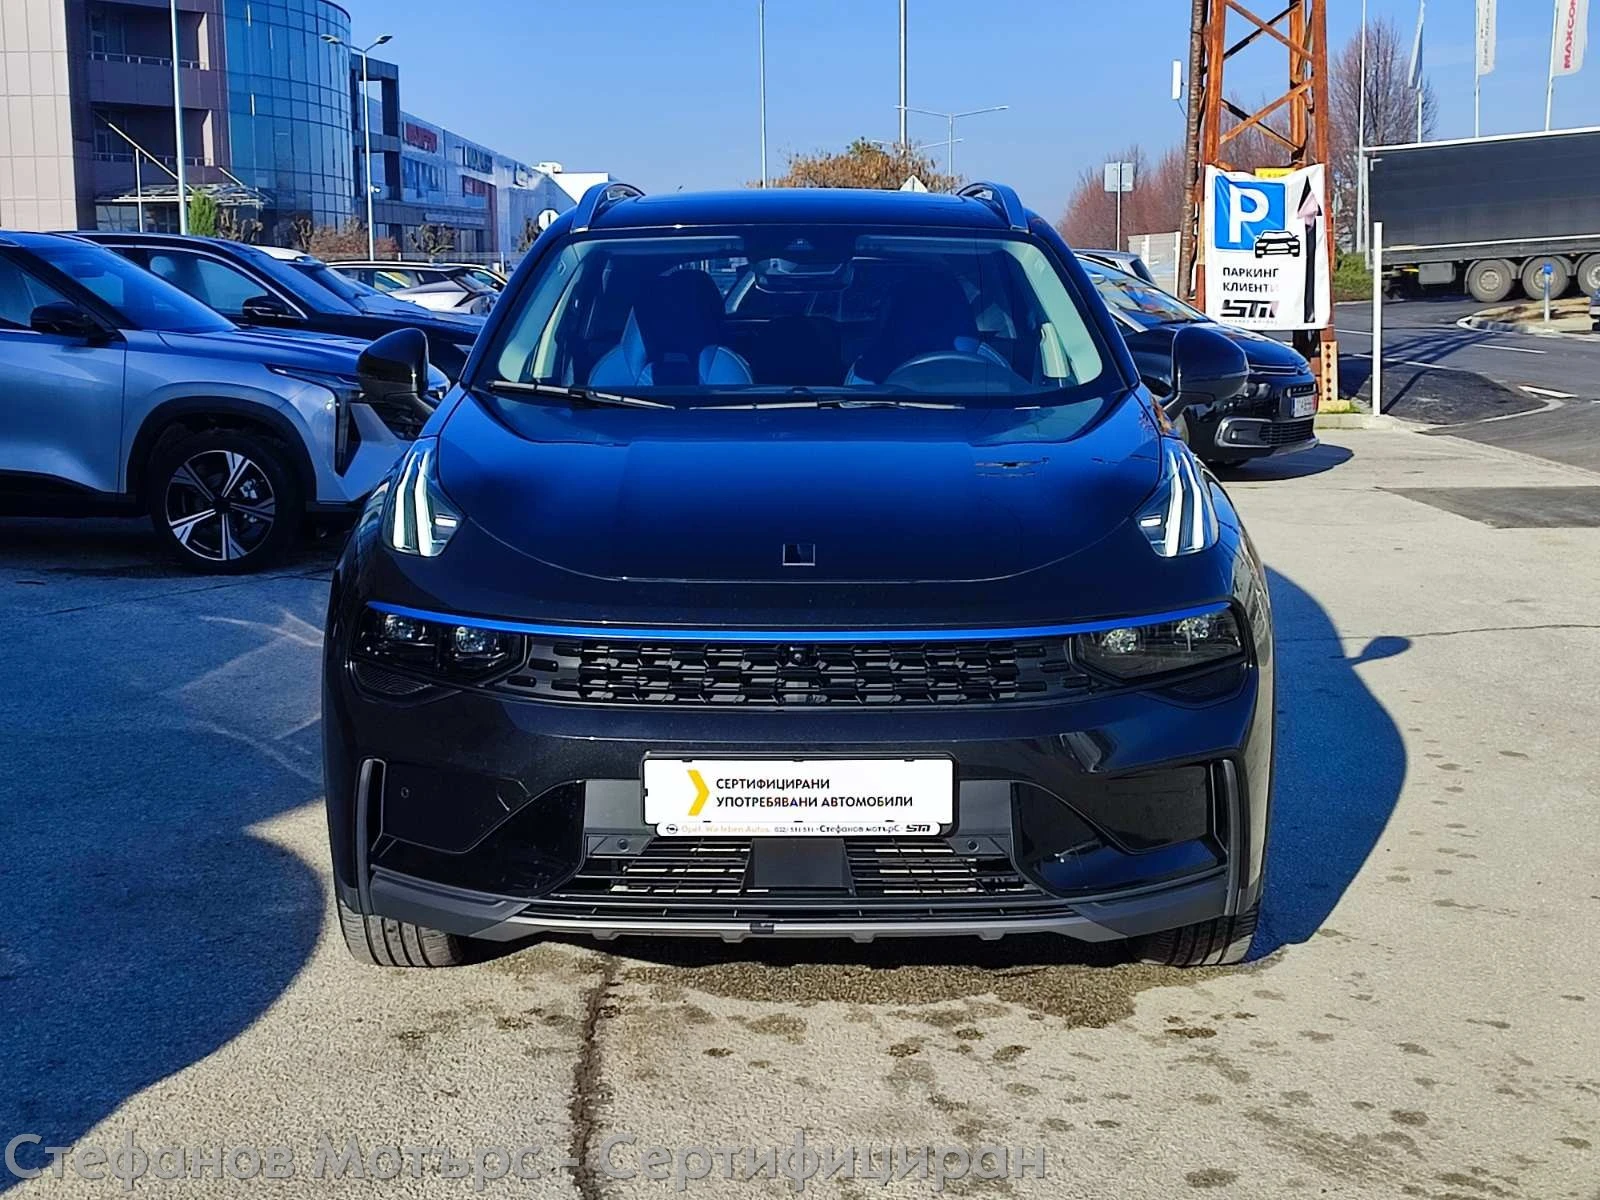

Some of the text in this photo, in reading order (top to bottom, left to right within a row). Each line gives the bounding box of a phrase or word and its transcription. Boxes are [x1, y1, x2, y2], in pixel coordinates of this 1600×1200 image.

[1228, 183, 1270, 243] P
[1222, 267, 1280, 278] ПАРКИНГ
[715, 778, 830, 790] СЕРТИФИЦИРАНИ
[716, 796, 913, 808] УПОТРЕБЯВАНИ АВТОМОБИЛИ
